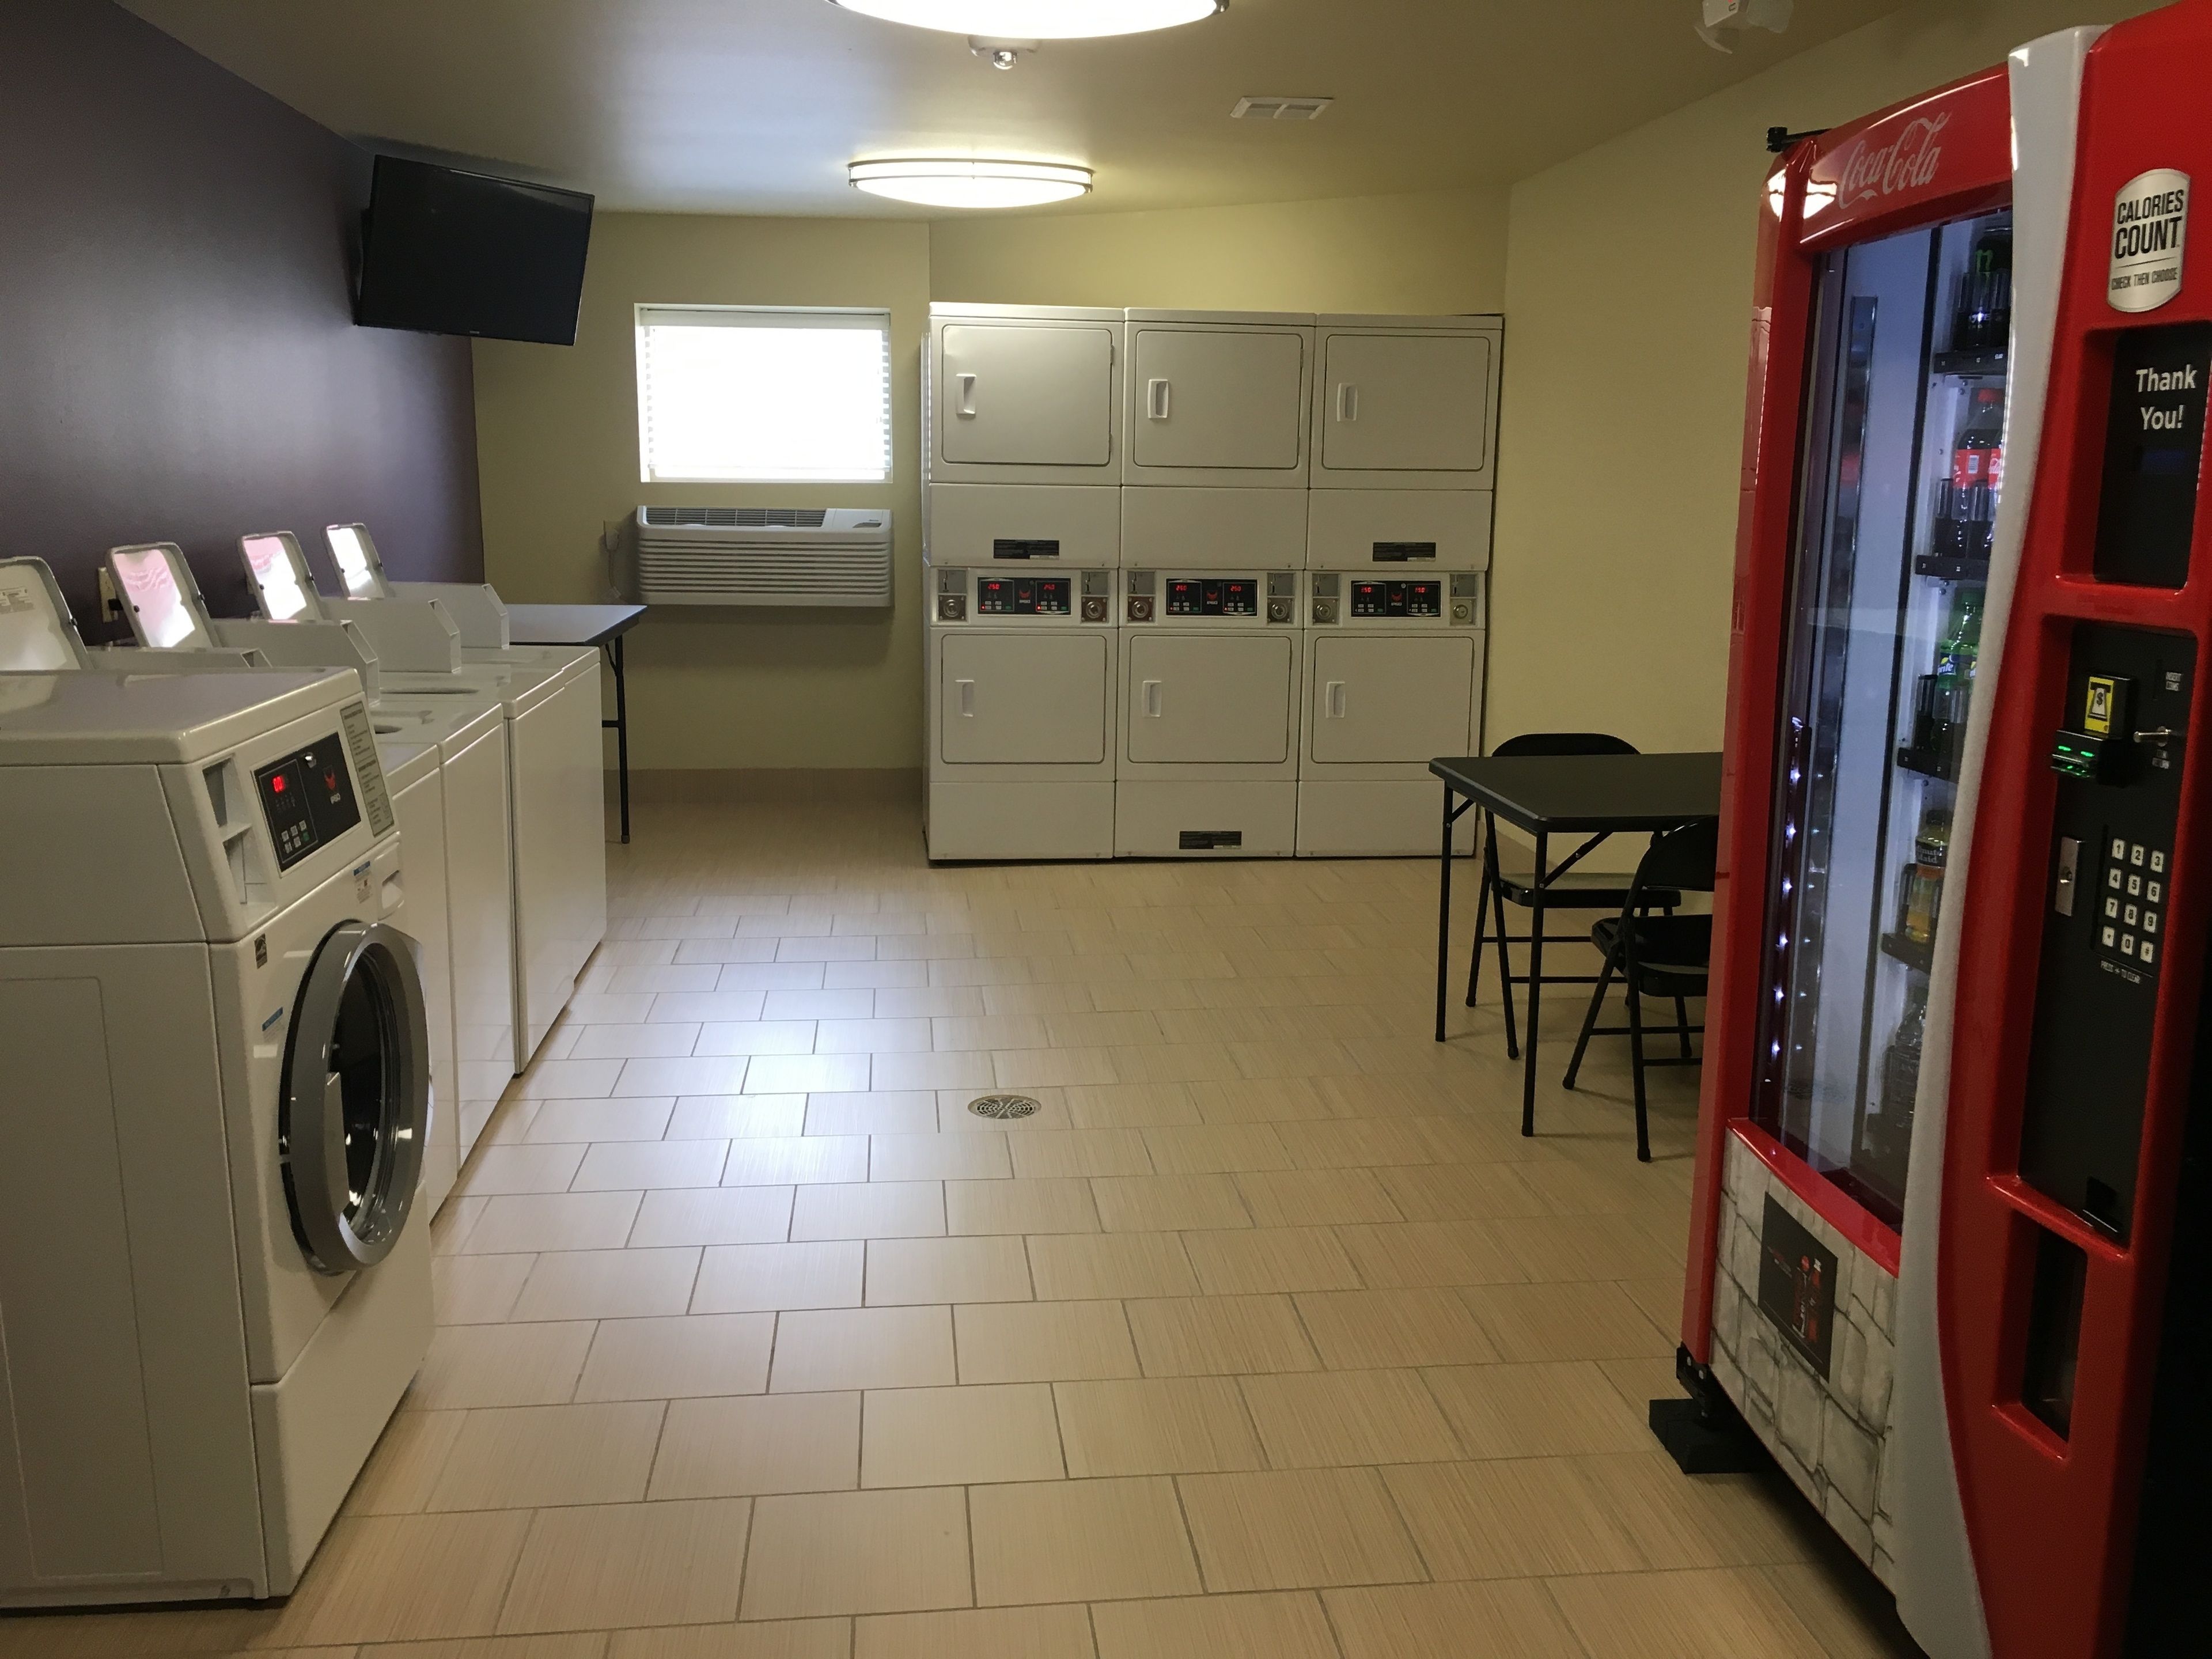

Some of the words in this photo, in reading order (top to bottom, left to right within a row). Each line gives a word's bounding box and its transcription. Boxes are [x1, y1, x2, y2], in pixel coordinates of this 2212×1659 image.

[1839, 112, 1952, 209] Coca-Cola
[2117, 189, 2184, 225] CALORIES
[2115, 216, 2182, 259] COUNT
[2111, 275, 2131, 290] CHECK
[2134, 272, 2150, 286] THEN
[2152, 267, 2178, 283] CHOOSE
[2135, 363, 2198, 392] Thank
[2140, 404, 2185, 430] You!
[2116, 843, 2121, 855] 1
[2135, 849, 2141, 861] 2
[2154, 855, 2161, 866] 3
[2112, 873, 2118, 884] 4
[2131, 879, 2137, 890] 5
[2151, 886, 2157, 897] 6
[2109, 902, 2115, 912] 7
[2128, 908, 2134, 920] 8
[2147, 916, 2154, 927] 9
[2124, 938, 2130, 949] 0
